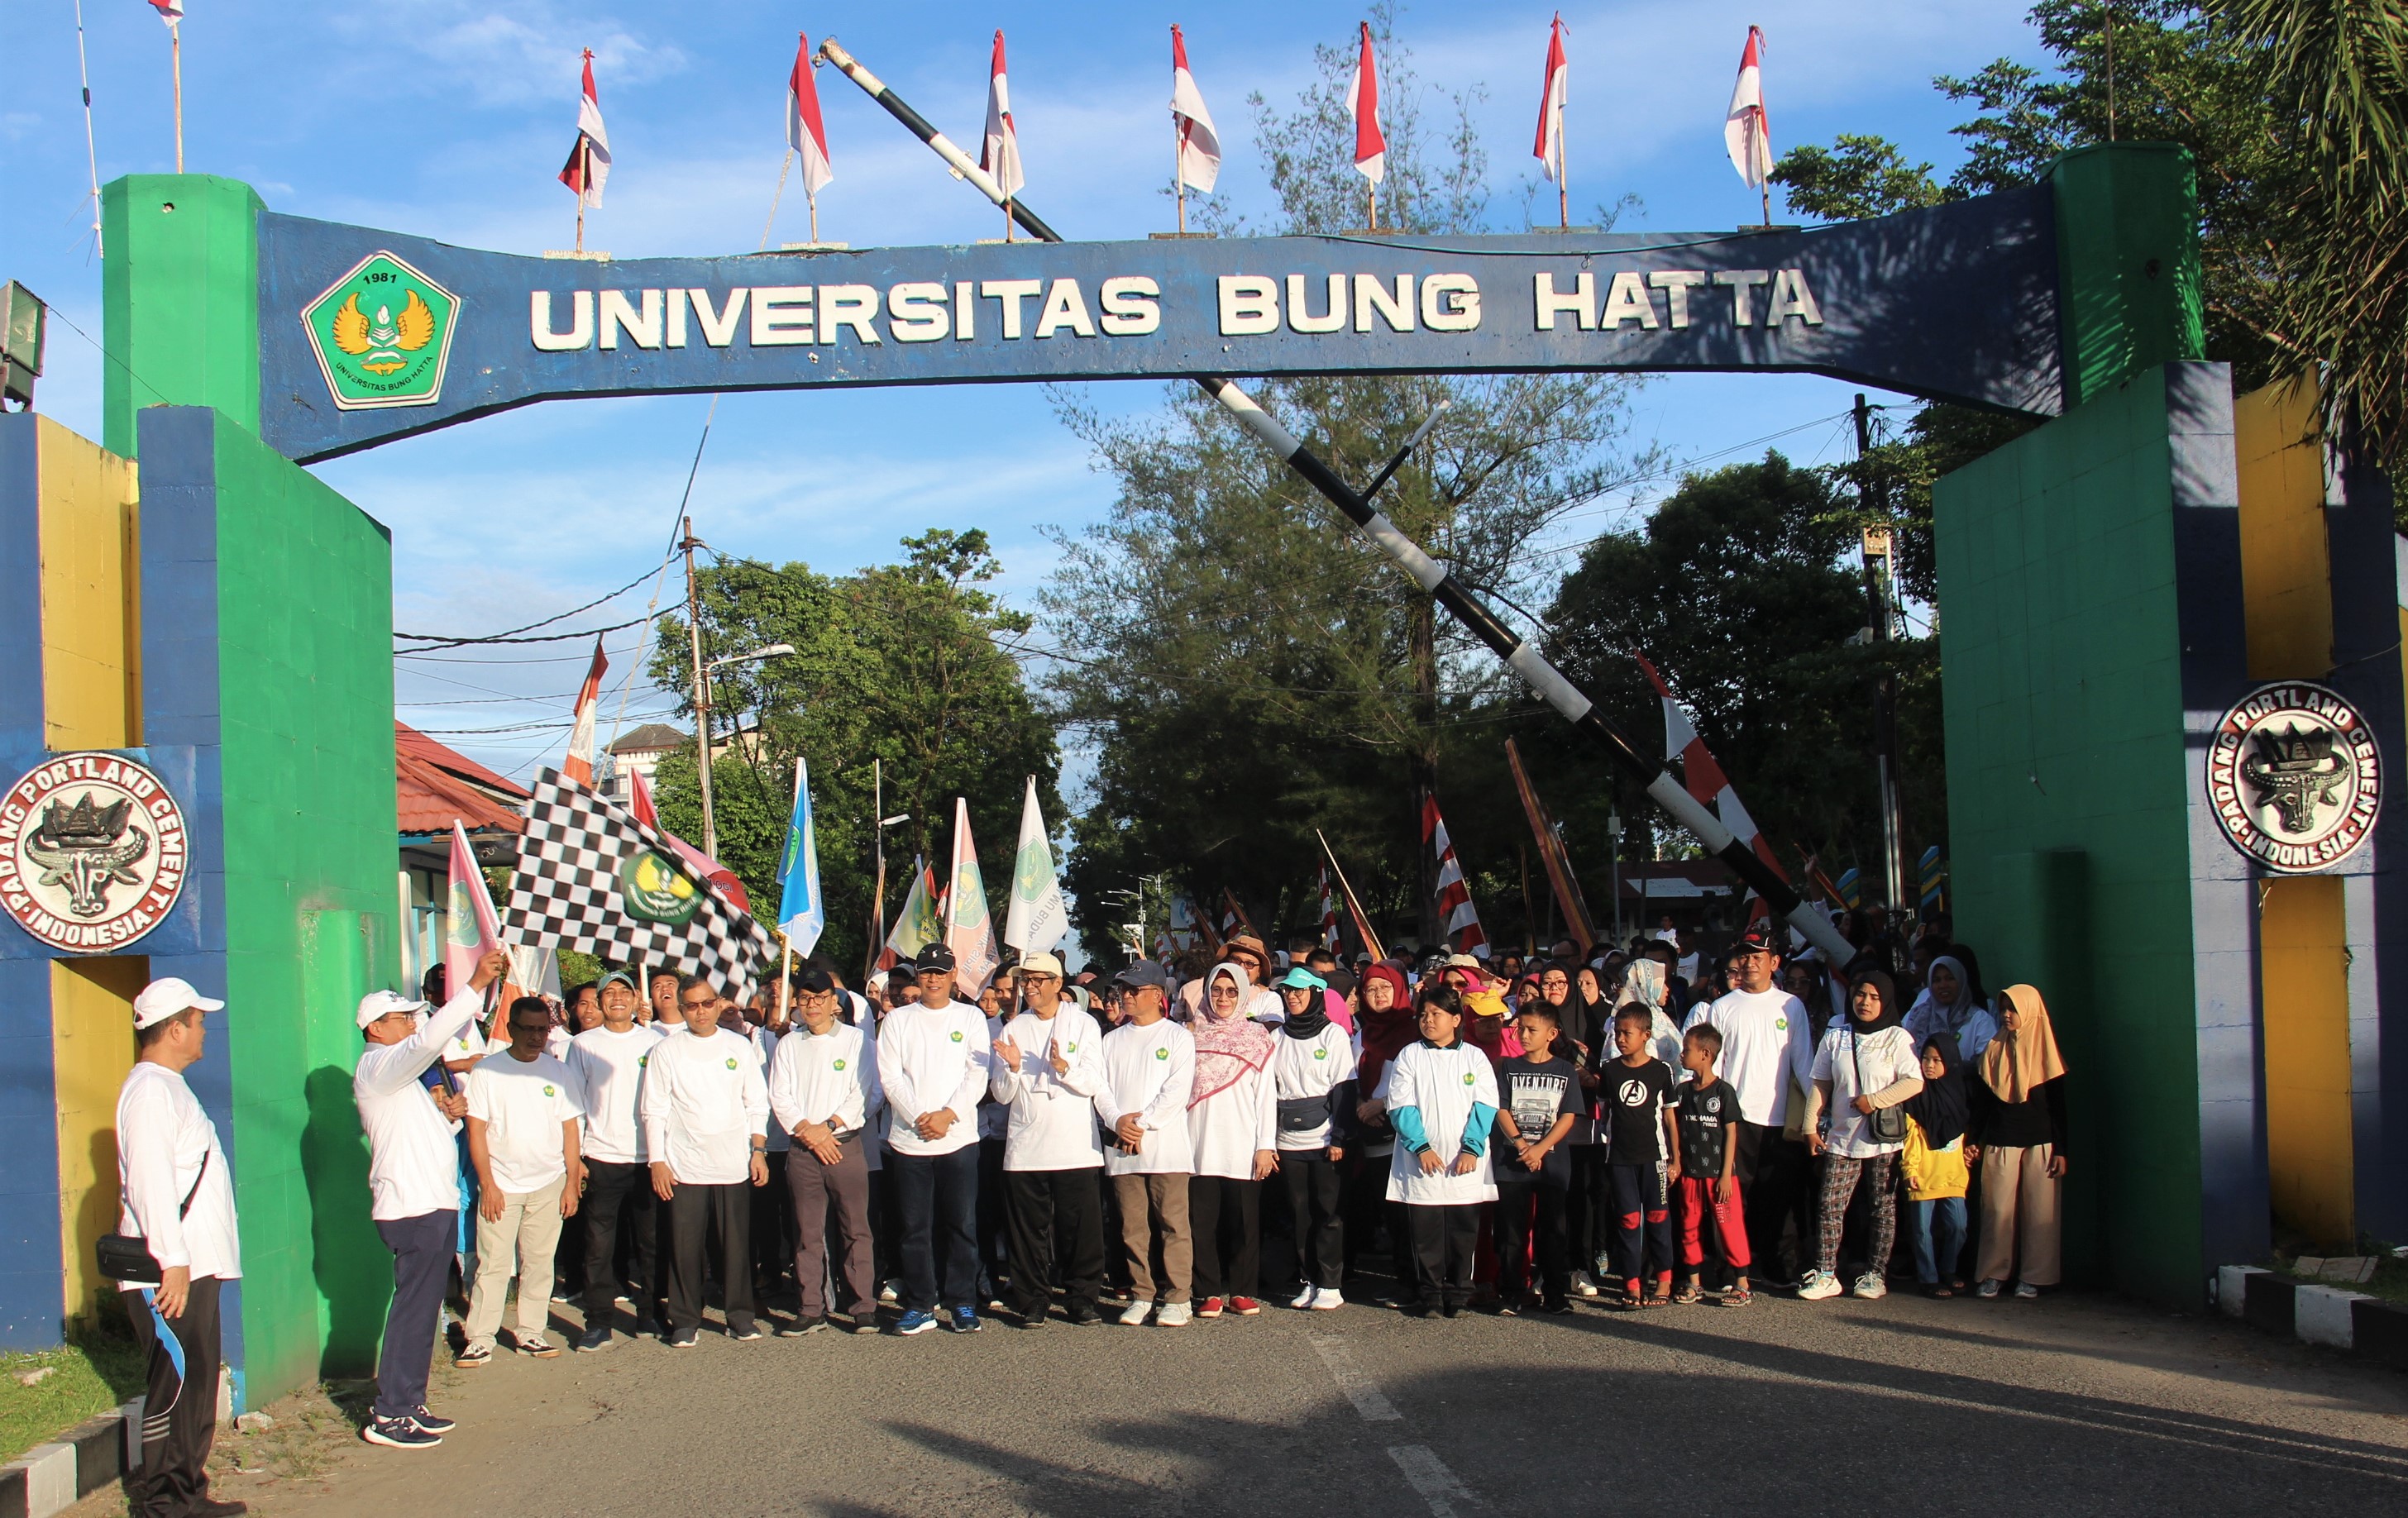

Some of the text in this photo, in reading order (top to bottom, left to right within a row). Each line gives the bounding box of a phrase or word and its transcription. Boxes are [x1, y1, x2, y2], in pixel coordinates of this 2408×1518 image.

[363, 273, 397, 284] 1981
[531, 269, 1823, 352] UNIVERSITAS BUNG HATTA
[336, 356, 432, 391] UNIVERSITAS BUNG HATTA
[2214, 690, 2378, 834] PADANG PORTLAND CEMENT
[0, 758, 183, 912] PADANG PORTLAND CEMENT
[2243, 831, 2356, 866] INDONESIA
[709, 876, 733, 892] LOGI
[26, 907, 153, 946] INDONESIA
[1512, 1076, 1565, 1095] DVENTURE
